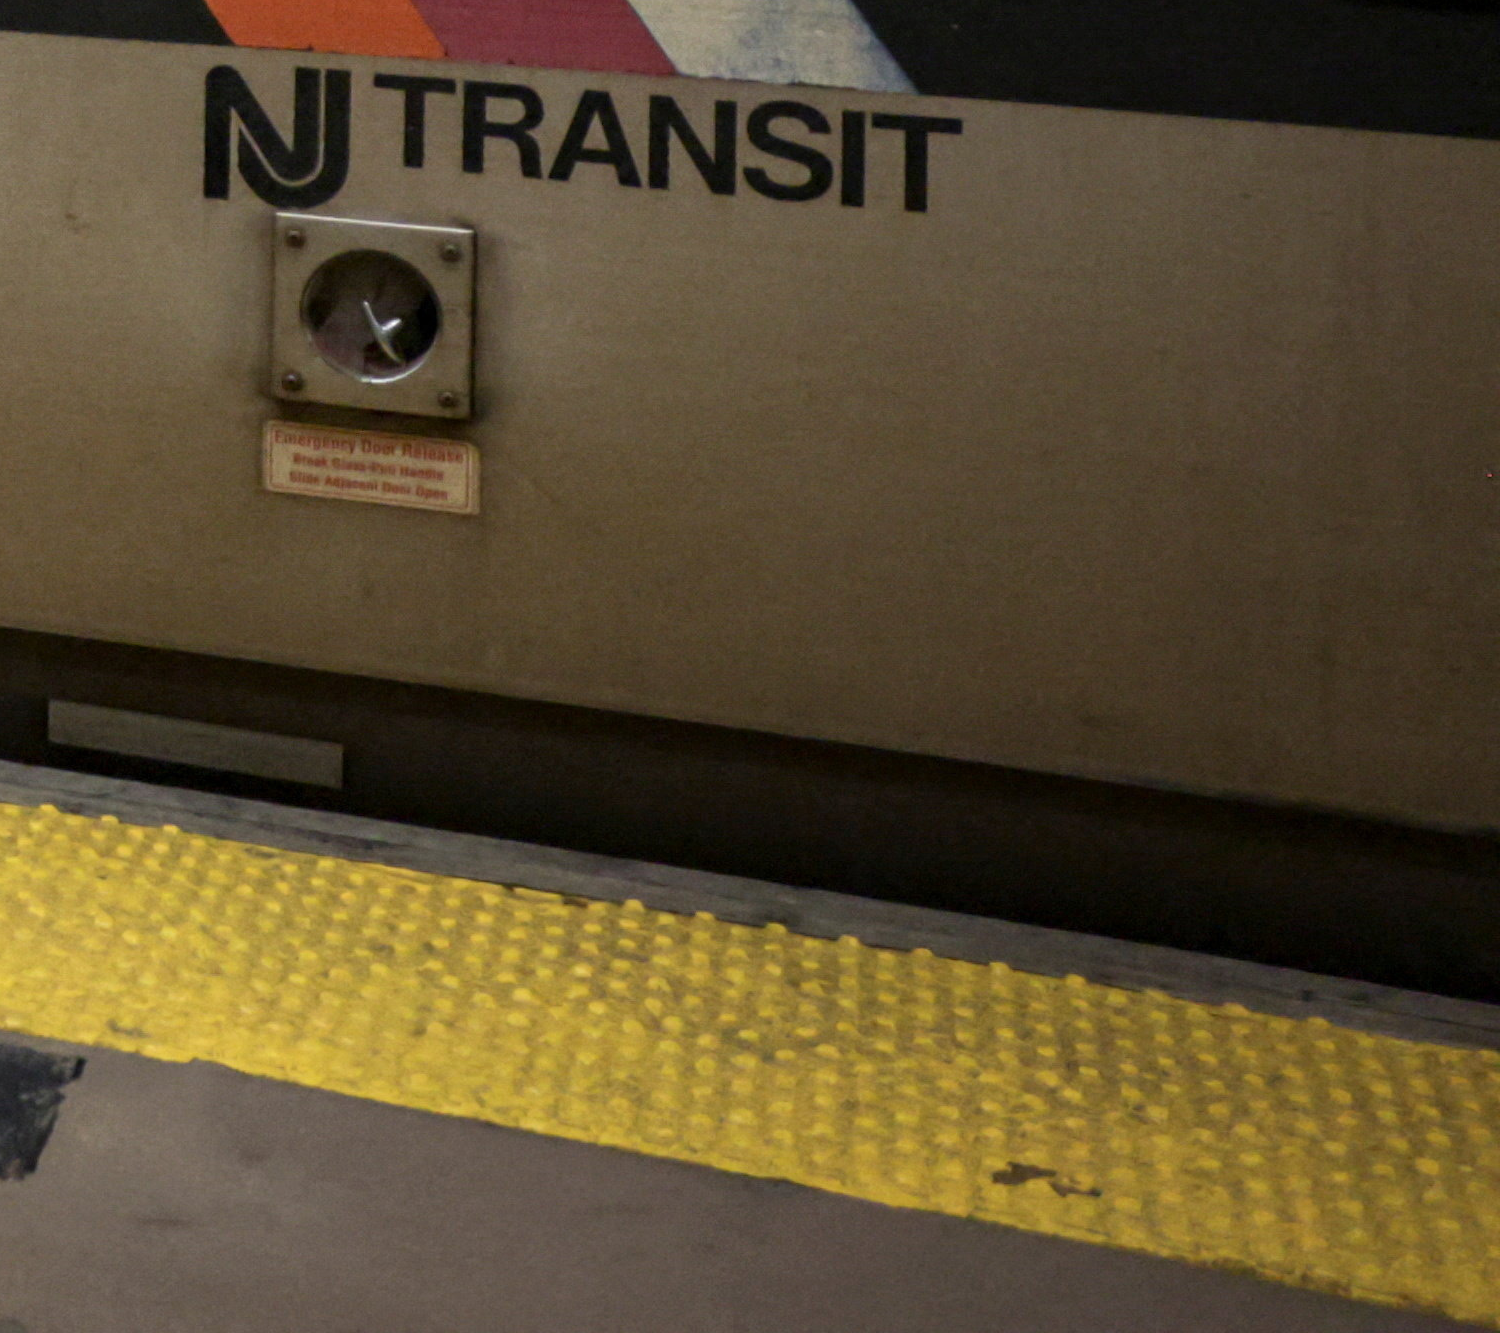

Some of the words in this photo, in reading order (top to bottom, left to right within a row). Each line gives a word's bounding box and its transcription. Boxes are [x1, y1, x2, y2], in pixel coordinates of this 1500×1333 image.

[204, 65, 351, 209] NJ
[373, 73, 963, 213] TRANSIT
[275, 430, 356, 454] Emergency
[361, 439, 395, 456] Door
[401, 442, 463, 464] Release
